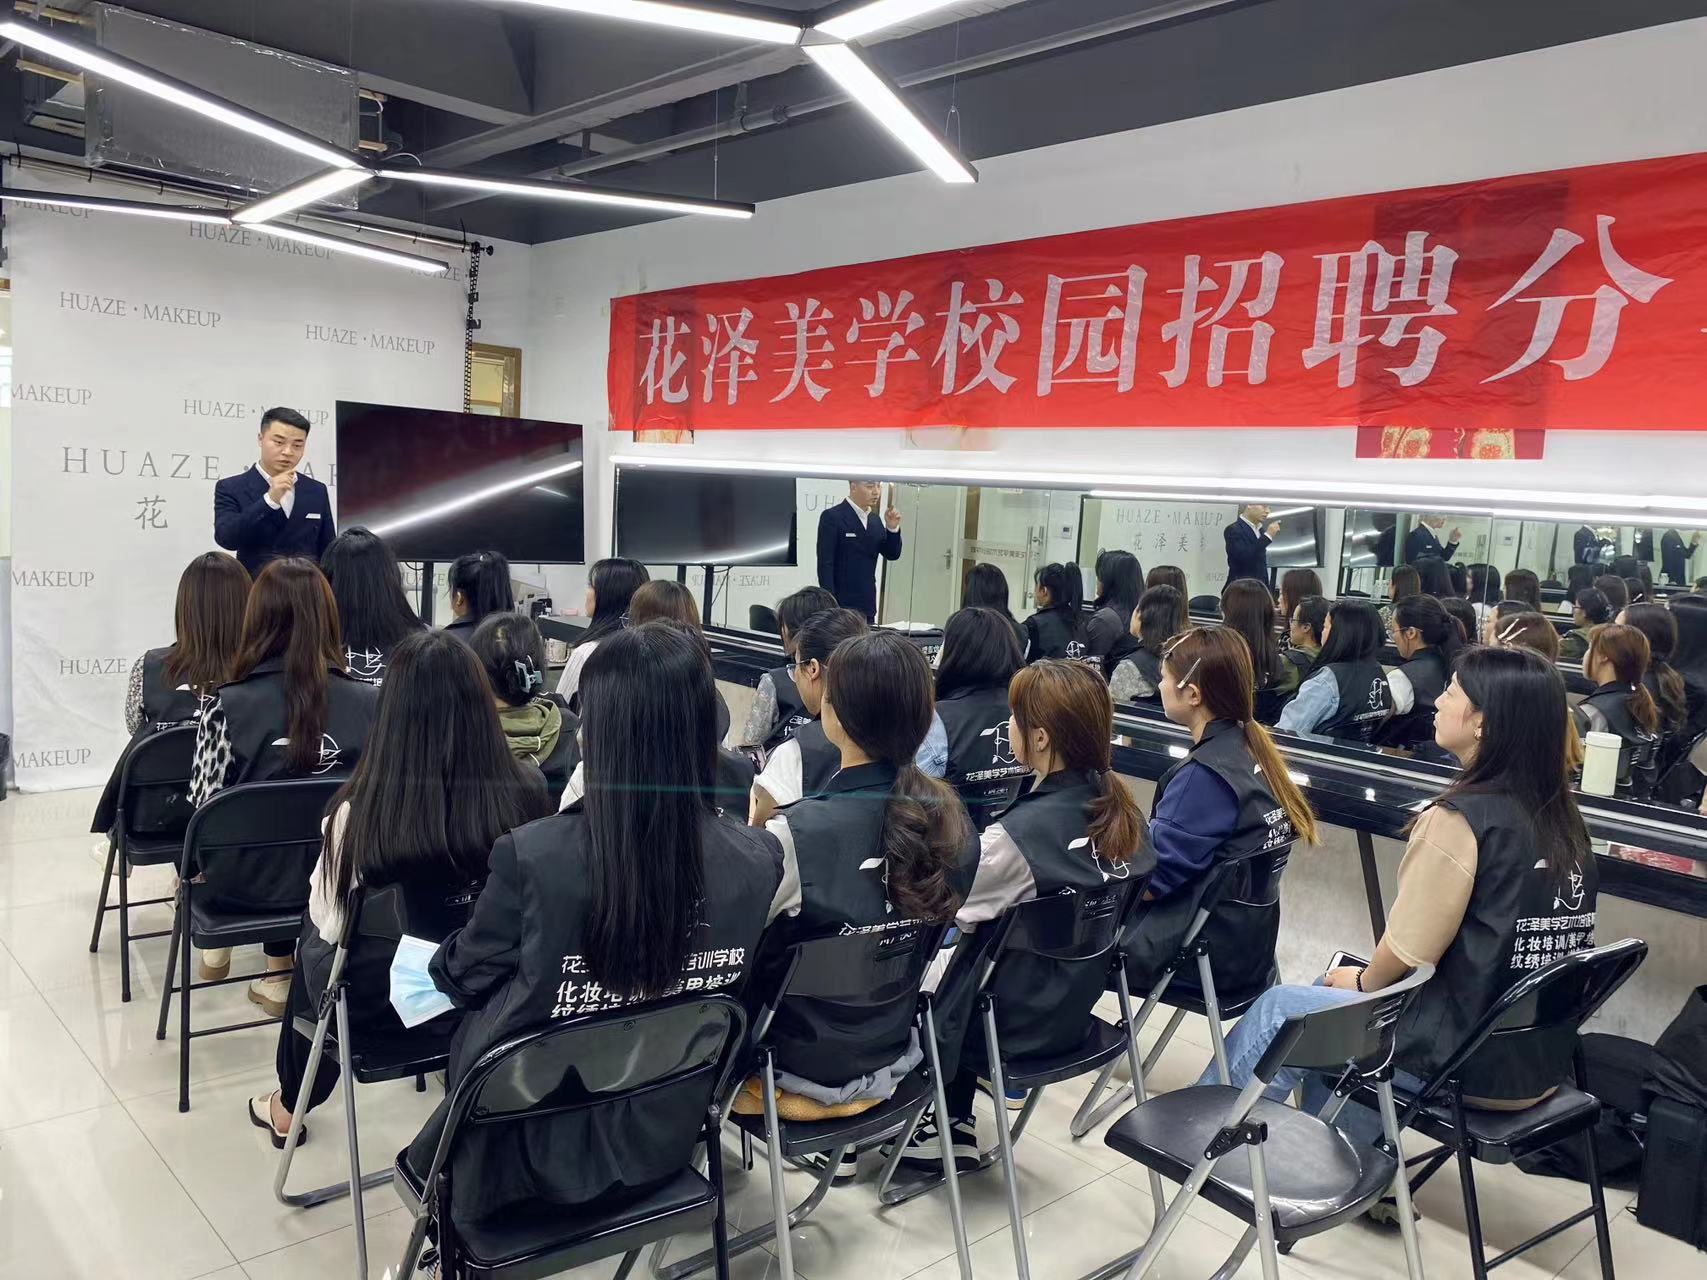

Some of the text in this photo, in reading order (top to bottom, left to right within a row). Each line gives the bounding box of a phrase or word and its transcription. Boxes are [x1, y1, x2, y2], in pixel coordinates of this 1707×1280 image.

[189, 221, 250, 246] HUAZE
[60, 291, 222, 328] HUAZE MAKEUP
[637, 213, 1707, 406] 花泽美学校园招聘分
[305, 324, 436, 355] HUAZE MAKEUP
[11, 383, 92, 406] MAKEUP
[184, 399, 246, 419] HUAZE
[62, 446, 221, 481] HUAZE
[134, 494, 169, 530] 花
[12, 570, 95, 588] MAKEUP
[60, 658, 128, 675] HUAZE
